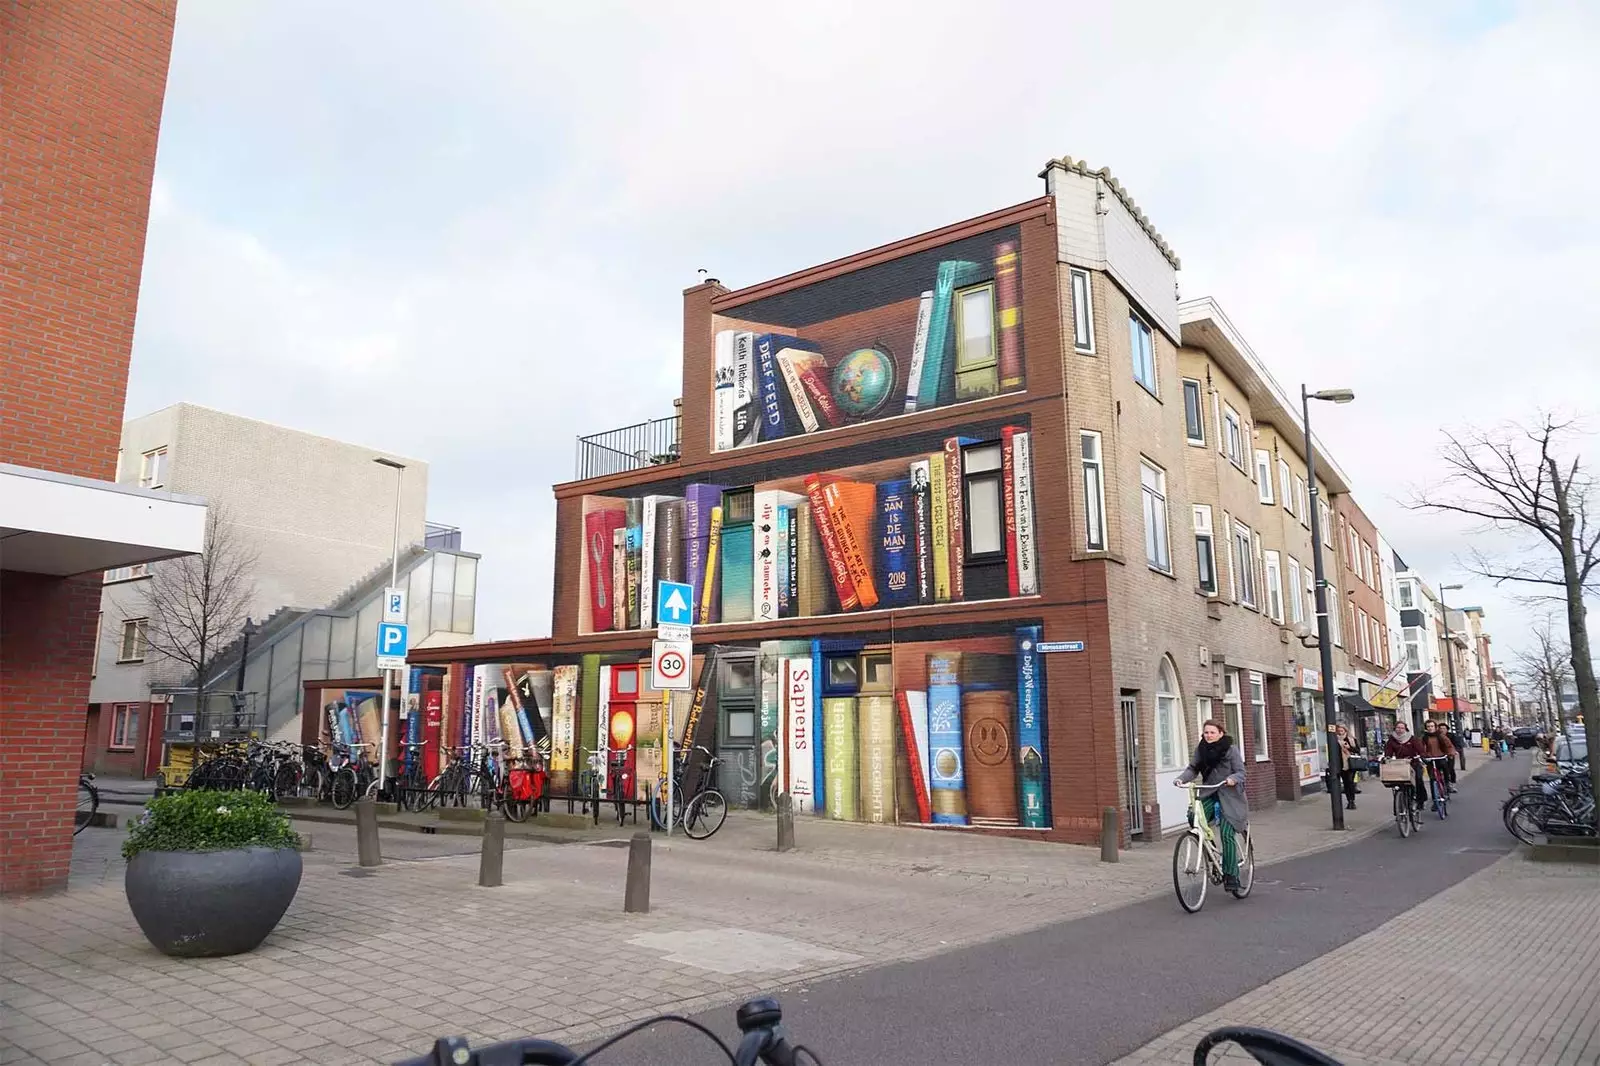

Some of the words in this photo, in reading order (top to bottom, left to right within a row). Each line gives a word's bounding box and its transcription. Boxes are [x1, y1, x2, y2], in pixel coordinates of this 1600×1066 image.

[738, 336, 747, 361] Keith
[738, 363, 747, 399] Richards
[1003, 446, 1012, 470] PAN
[884, 501, 904, 512] JAN
[1005, 475, 1016, 534] TADEUSZ
[838, 506, 847, 521] THE
[845, 523, 858, 551] SUBTLE
[886, 524, 902, 534] DE
[889, 514, 899, 523] IS
[764, 535, 771, 546] en
[831, 512, 841, 527] NOT
[838, 528, 849, 554] GIVING
[883, 535, 906, 547] MAN
[761, 559, 772, 600] Janneke
[888, 571, 906, 585] 2019
[392, 596, 400, 605] P
[384, 627, 402, 653] P
[663, 659, 681, 670] 30
[696, 688, 705, 704] De
[791, 670, 809, 750] Sapiens
[830, 702, 845, 774] Evelien
